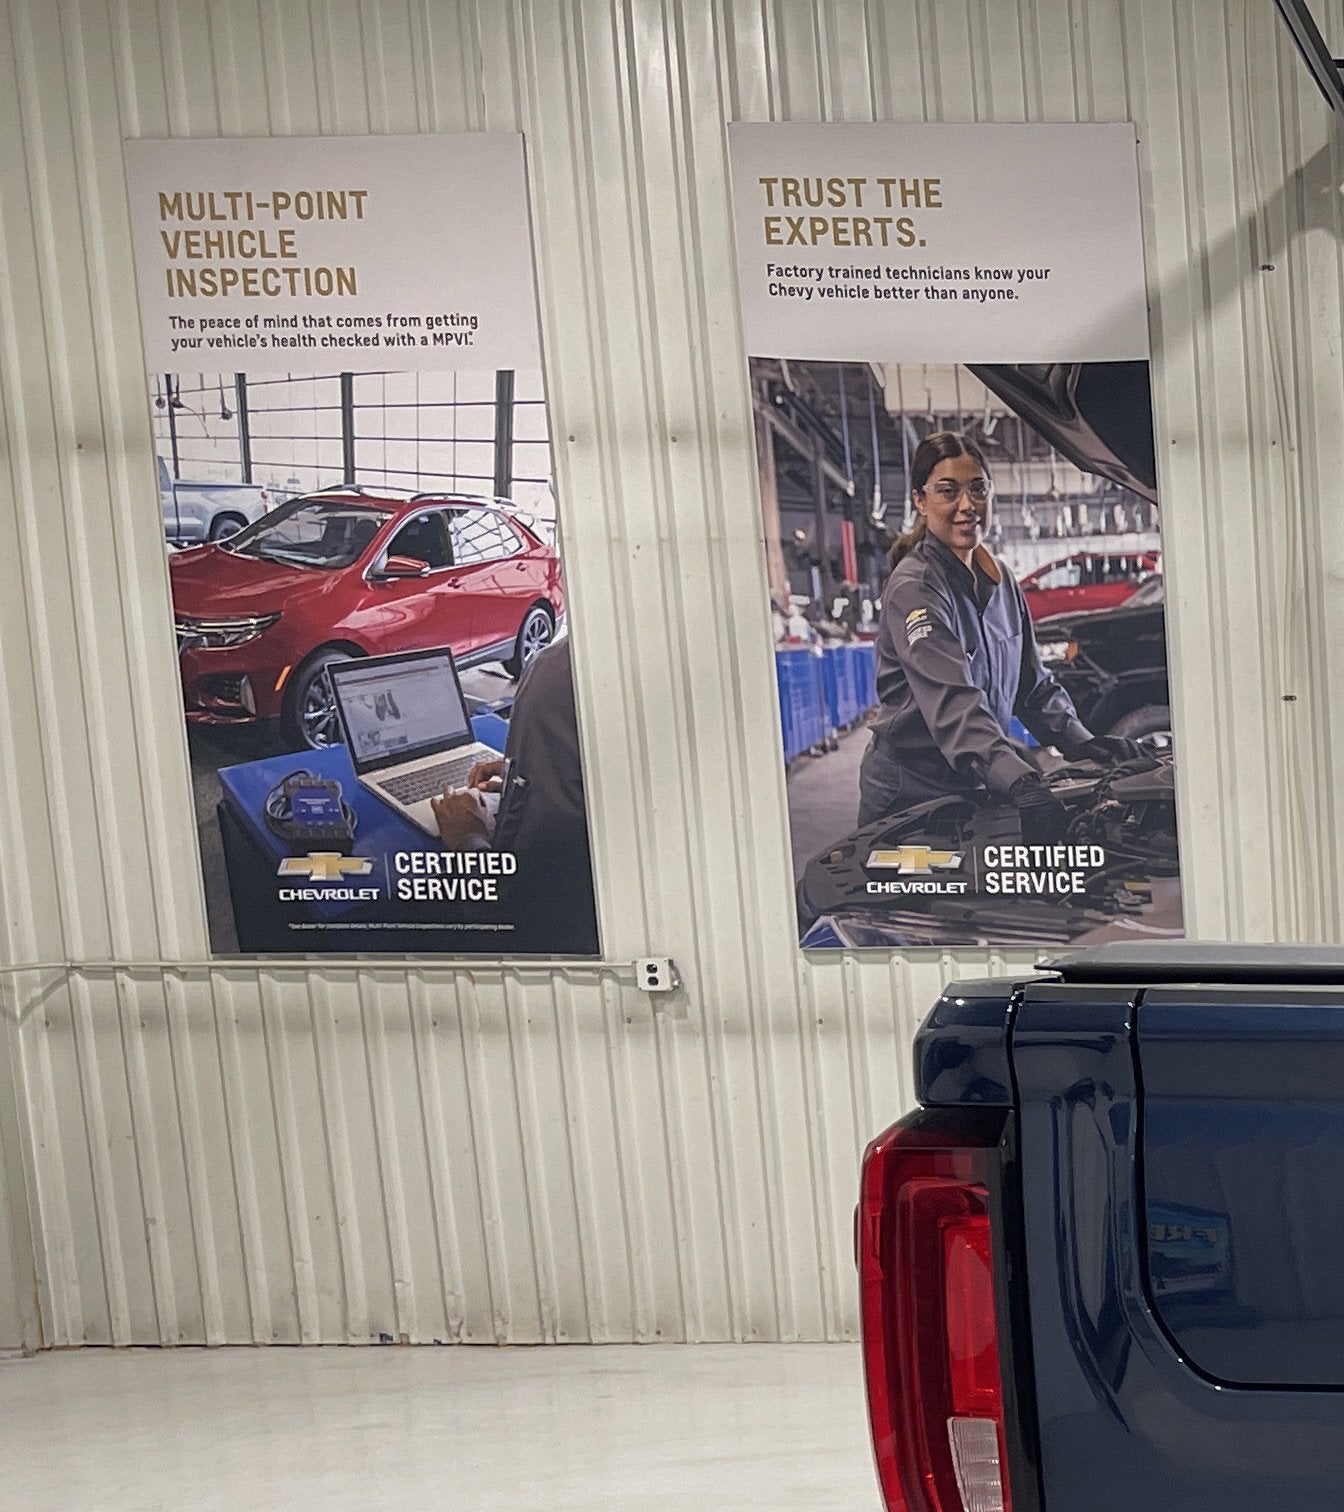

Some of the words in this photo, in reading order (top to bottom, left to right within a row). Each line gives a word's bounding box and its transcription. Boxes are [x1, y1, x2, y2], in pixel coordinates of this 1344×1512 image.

[759, 178, 866, 207] TRUST
[877, 179, 942, 208] THE
[158, 191, 367, 221] MULTI-POINT
[765, 217, 926, 247] EXPERTS.
[160, 230, 297, 259] VEHICLE
[166, 268, 356, 297] INSPECTION
[767, 264, 823, 283] Factory
[828, 265, 881, 279] trained
[886, 266, 970, 279] technicians
[975, 266, 1013, 279] know
[1017, 269, 1050, 283] your
[769, 283, 813, 300] Chevy
[818, 285, 869, 298] vehicle
[874, 285, 920, 299] better
[924, 286, 957, 299] than
[963, 289, 1018, 303] anyone.
[169, 316, 194, 329] The
[200, 319, 240, 332] peace
[246, 315, 258, 328] of
[264, 315, 298, 328] mind
[302, 315, 332, 328] that
[337, 318, 382, 327] comes
[387, 314, 421, 327] from
[426, 313, 477, 332] getting
[171, 338, 203, 351] your
[207, 334, 267, 347] vehicle's
[272, 334, 316, 347] health
[321, 333, 379, 347] checked
[384, 333, 415, 346] with
[421, 336, 428, 345] a
[395, 852, 516, 874] CERTIFIED
[984, 846, 1104, 867] CERTIFIED
[398, 878, 498, 900] SERVICE
[867, 882, 967, 893] CHEVROLET
[986, 872, 1085, 893] SERVICE
[279, 889, 379, 900] CHEVROLET
